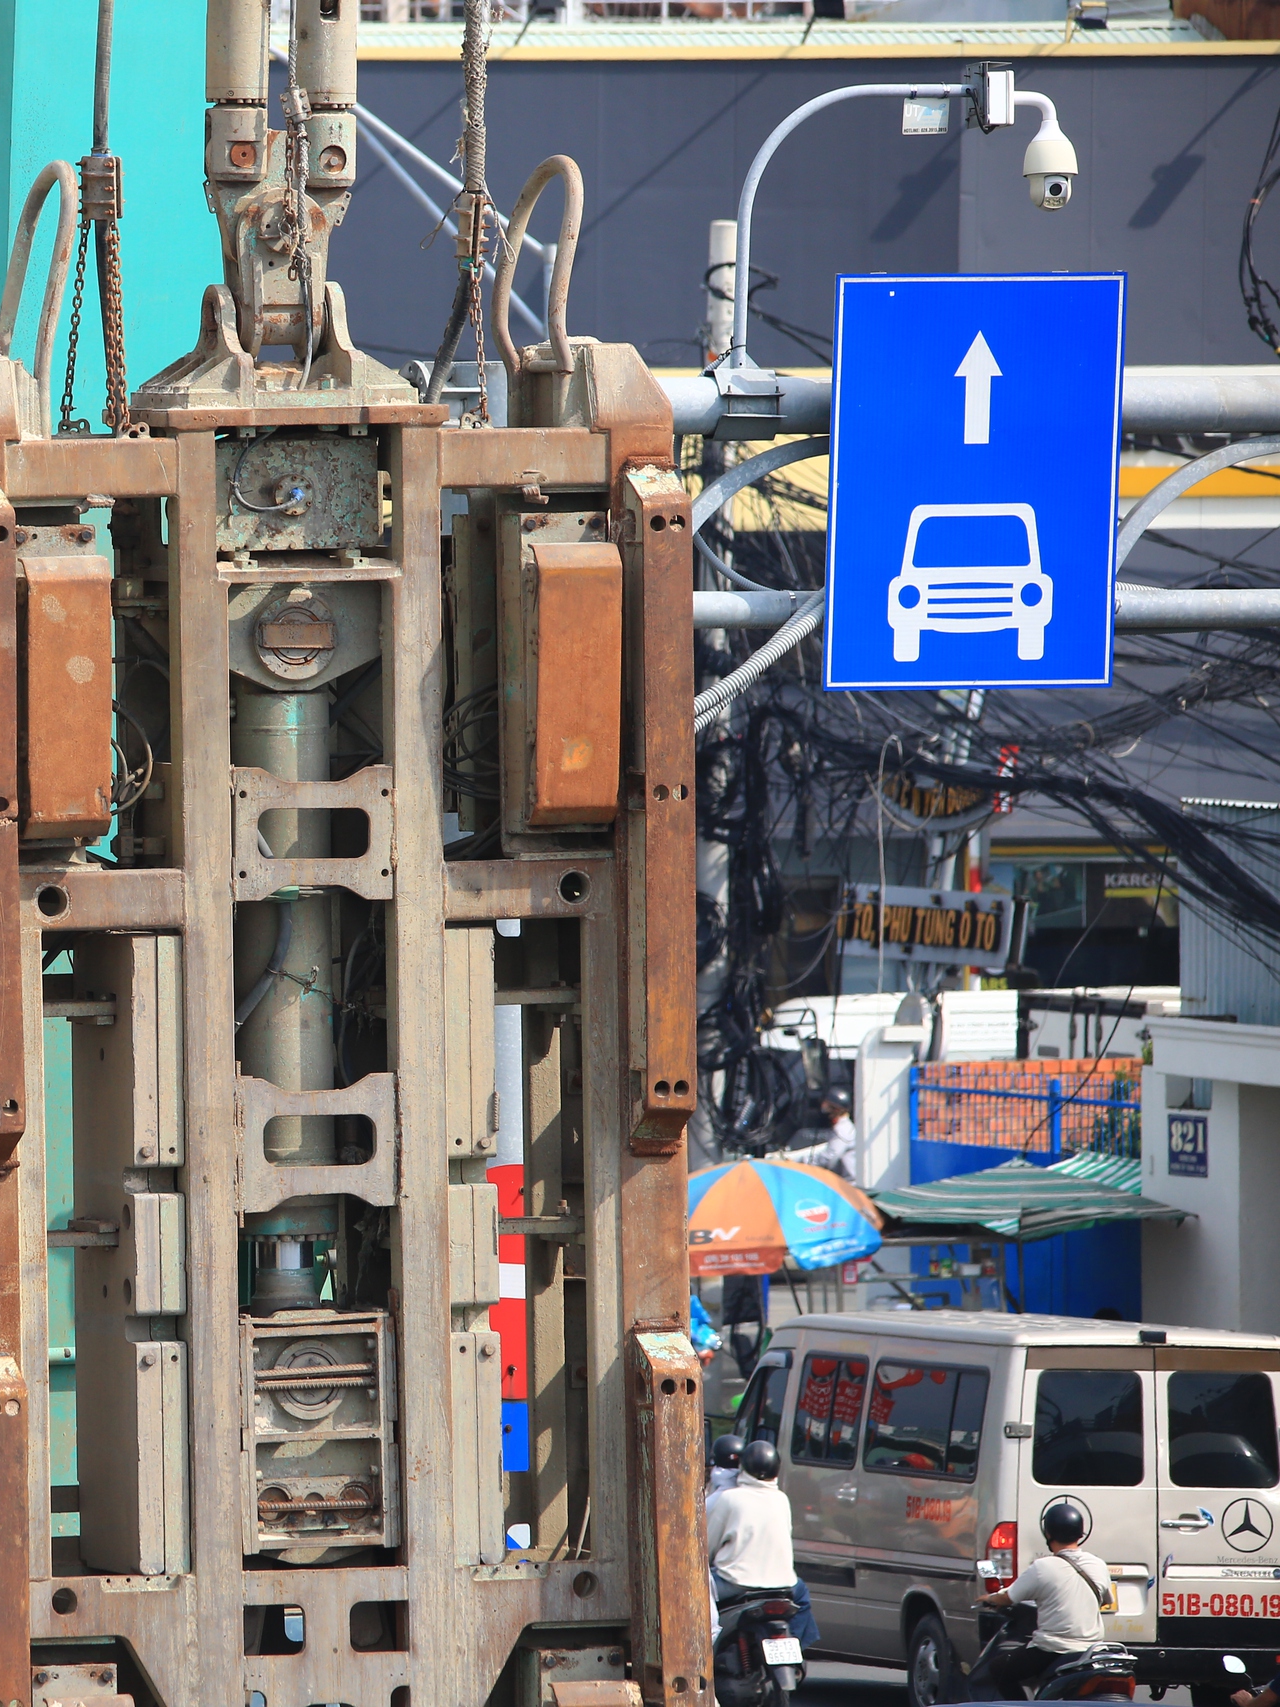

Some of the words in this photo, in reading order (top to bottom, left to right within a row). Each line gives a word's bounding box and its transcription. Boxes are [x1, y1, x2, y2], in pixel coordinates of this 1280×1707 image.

[1170, 1120, 1205, 1154] 821
[1216, 1555, 1278, 1564] Mercedes-Benz
[1162, 1593, 1280, 1618] 51B-080.19
